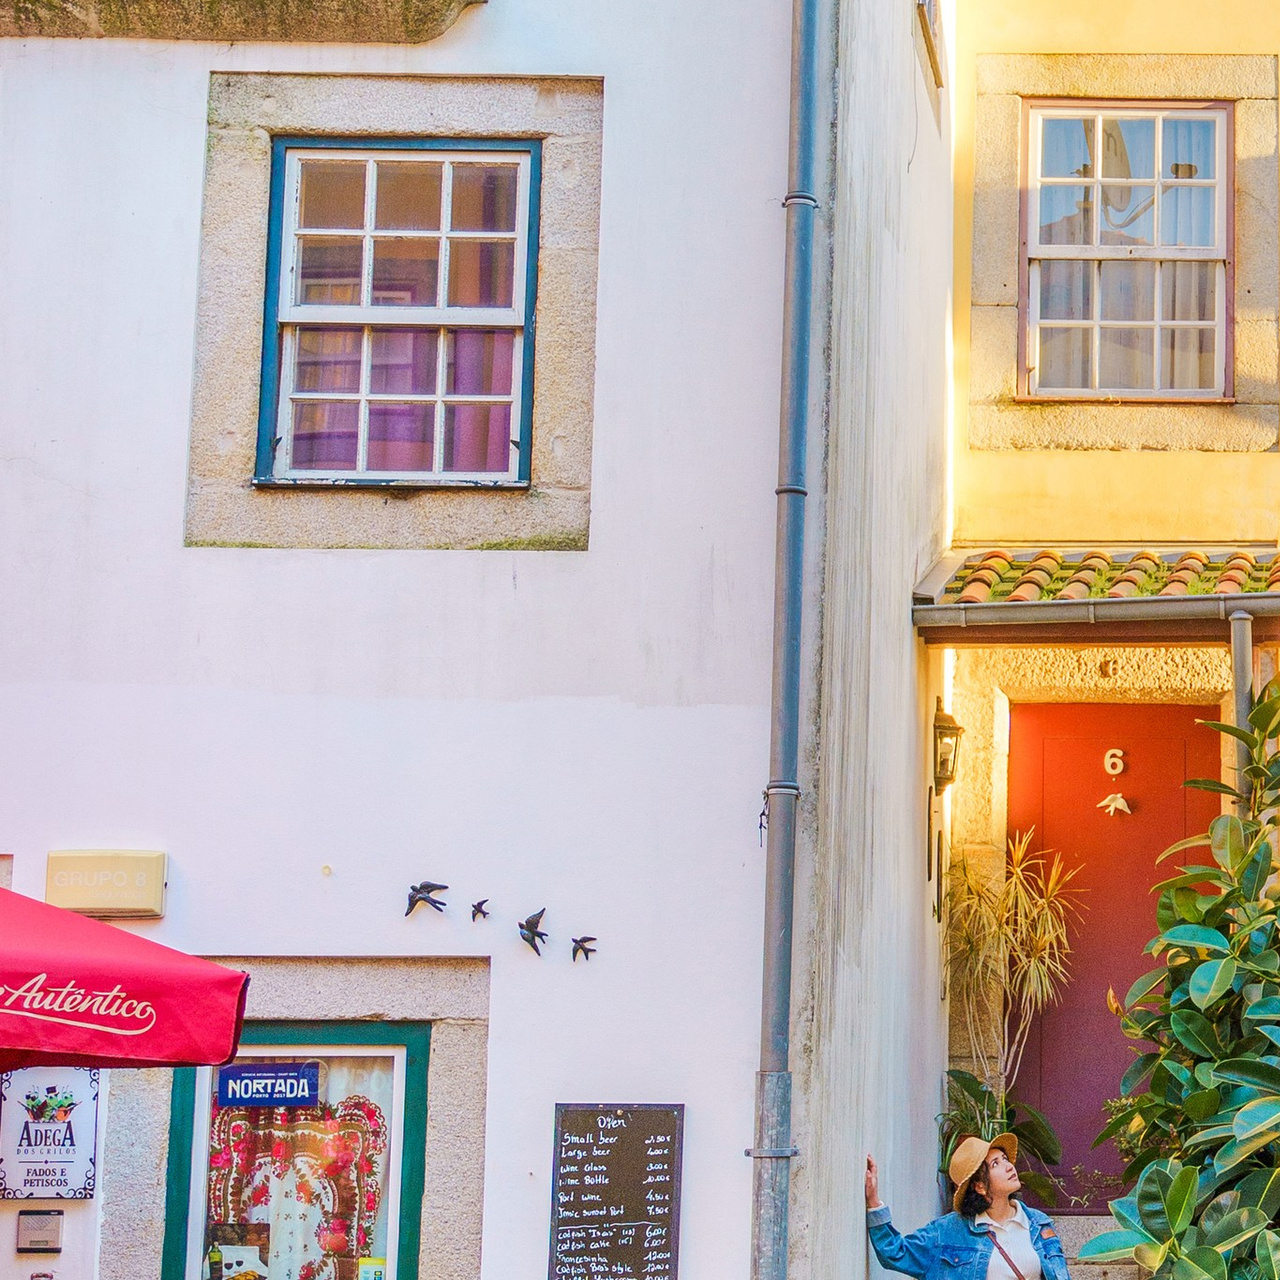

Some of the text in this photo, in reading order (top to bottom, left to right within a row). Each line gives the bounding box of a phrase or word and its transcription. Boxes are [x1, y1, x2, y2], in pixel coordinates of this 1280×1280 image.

[1104, 749, 1124, 775] 6
[55, 871, 146, 887] GRUPO 8
[4, 973, 154, 1019] Autêntico
[228, 1079, 309, 1098] NORTADA
[18, 1120, 76, 1147] ADEGA
[561, 1133, 593, 1145] Small
[598, 1131, 618, 1145] beer
[561, 1147, 587, 1159] Large
[592, 1146, 611, 1156] beer
[26, 1168, 67, 1177] FADOS E
[23, 1178, 69, 1187] PETISCOS
[558, 1192, 574, 1203] Port
[609, 1205, 624, 1216] Port
